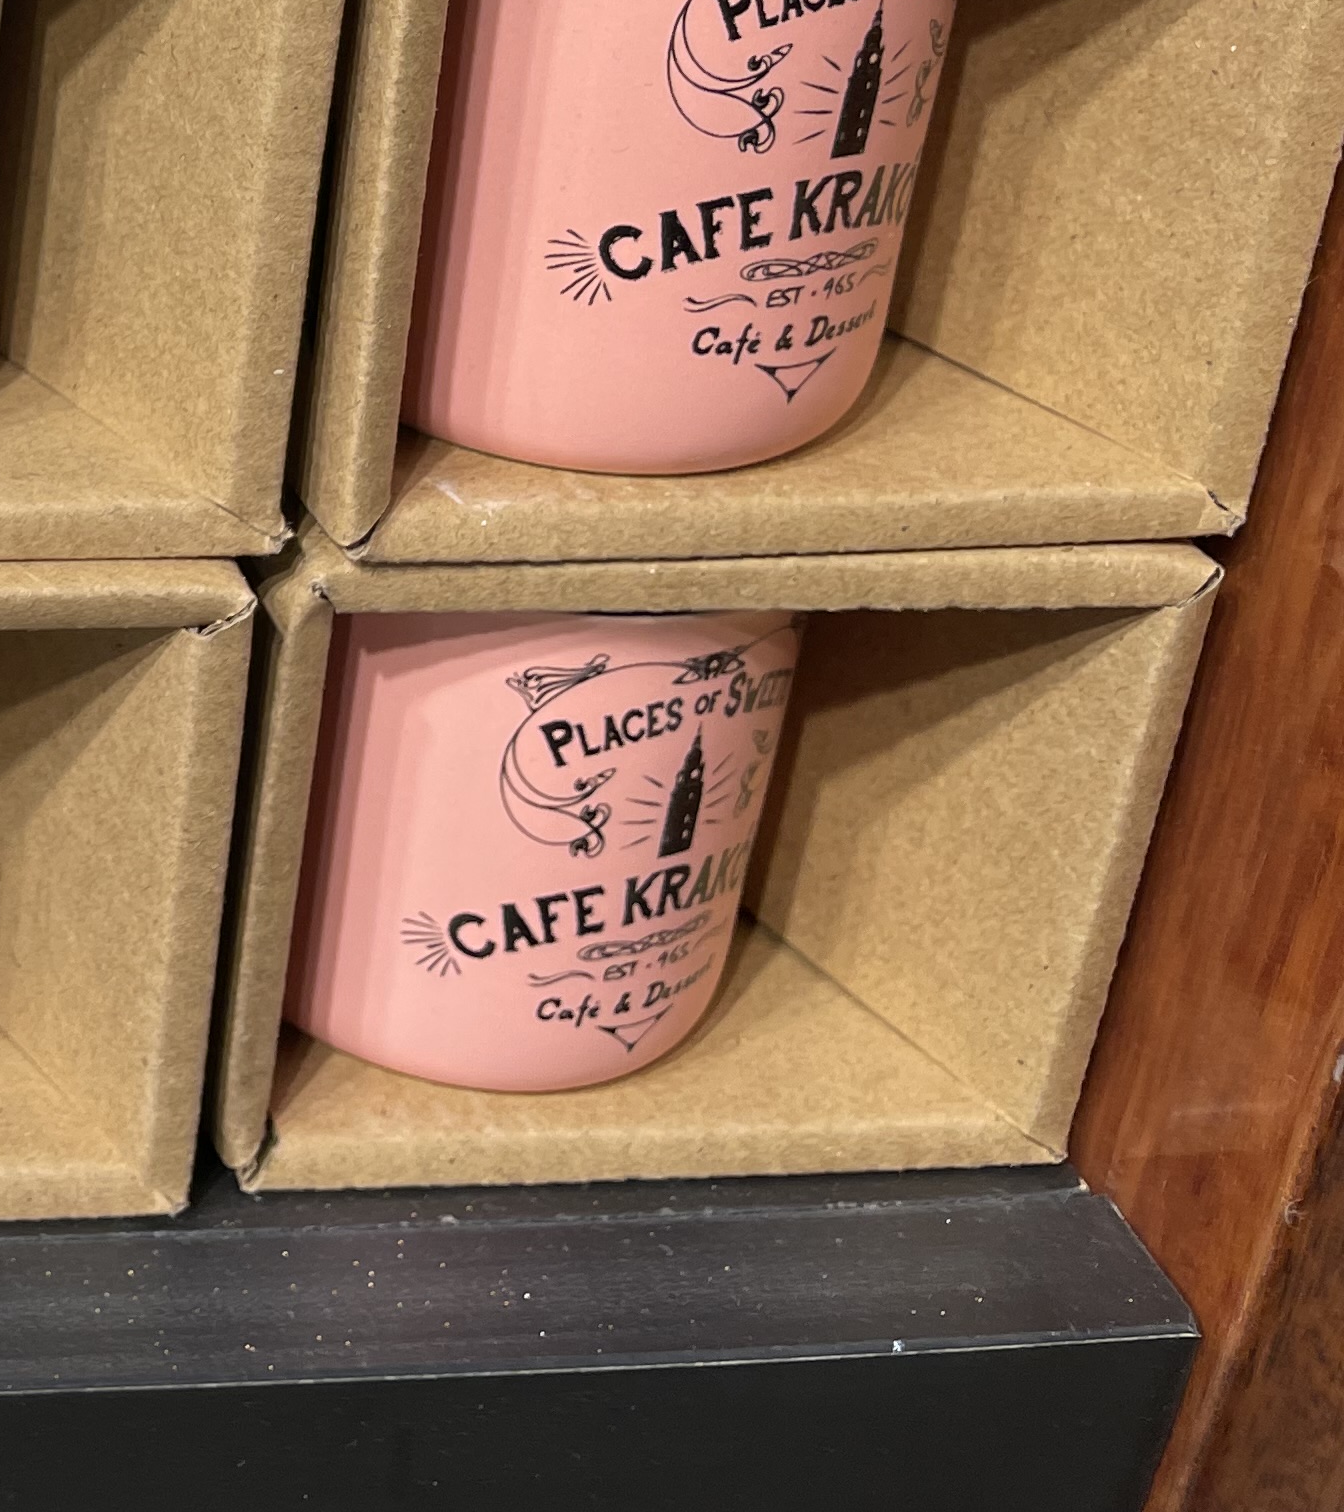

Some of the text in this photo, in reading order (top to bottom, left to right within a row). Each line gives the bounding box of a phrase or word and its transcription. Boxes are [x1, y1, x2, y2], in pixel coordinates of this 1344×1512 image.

[598, 187, 774, 282] CAFE
[823, 272, 857, 299] 965
[691, 323, 761, 365] Café
[774, 324, 794, 352] &
[539, 697, 684, 767] PLACES
[695, 689, 722, 716] OF
[448, 885, 606, 960] CAFE
[537, 993, 601, 1028] Café
[614, 991, 632, 1014] &
